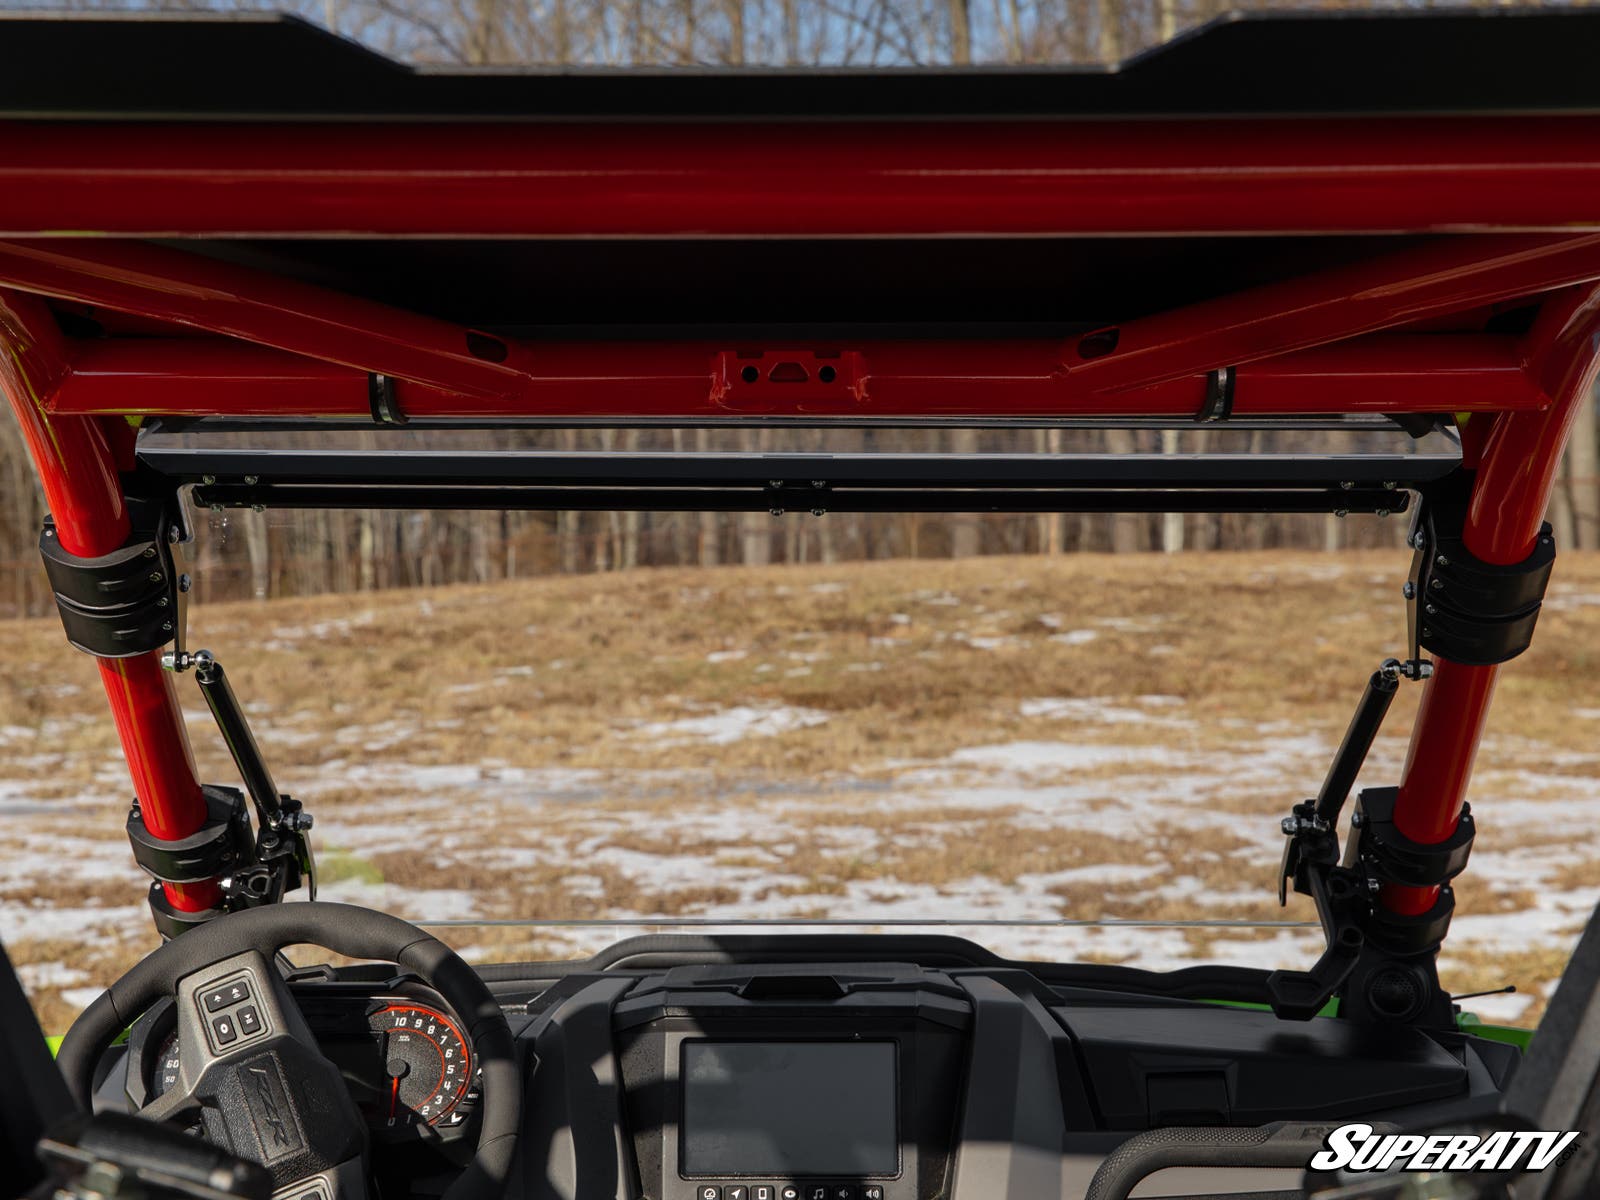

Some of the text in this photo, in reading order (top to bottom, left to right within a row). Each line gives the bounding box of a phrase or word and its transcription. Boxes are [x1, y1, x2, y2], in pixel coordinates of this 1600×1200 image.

[395, 1017, 407, 1027] 10
[414, 1019, 423, 1028] 9
[427, 1025, 436, 1035] 8
[440, 1036, 448, 1045] 7
[445, 1049, 454, 1058] 6
[166, 1059, 180, 1068] 60
[446, 1065, 455, 1074] 5
[165, 1075, 176, 1083] 50
[443, 1081, 451, 1091] 4
[434, 1095, 443, 1105] 3
[421, 1105, 430, 1115] 2
